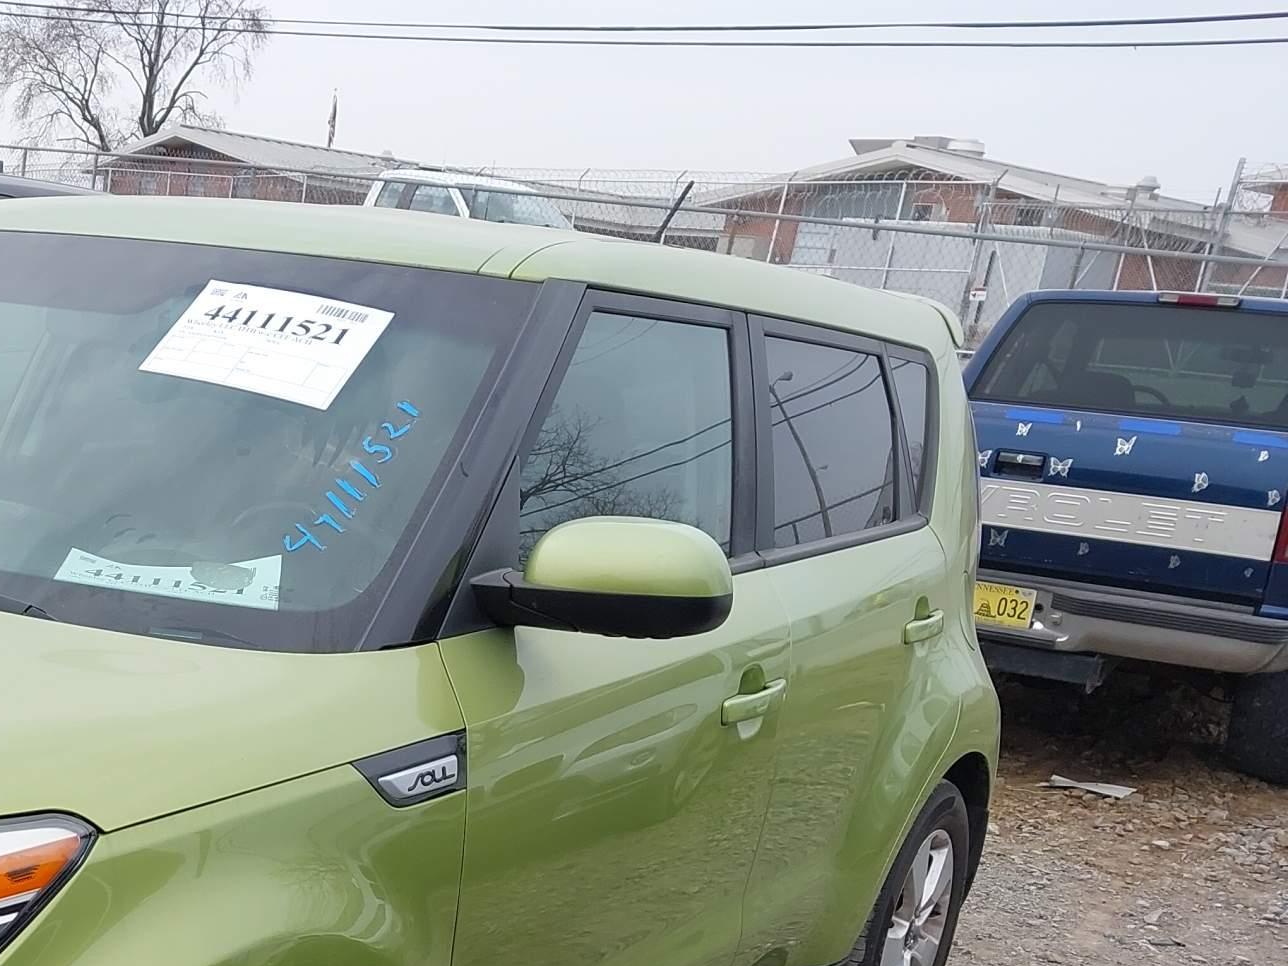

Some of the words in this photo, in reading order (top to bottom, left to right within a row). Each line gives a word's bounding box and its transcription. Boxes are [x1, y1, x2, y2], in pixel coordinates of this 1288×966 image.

[204, 303, 350, 345] 44111521
[997, 597, 1029, 620] 032
[407, 766, 456, 792] SOUL
